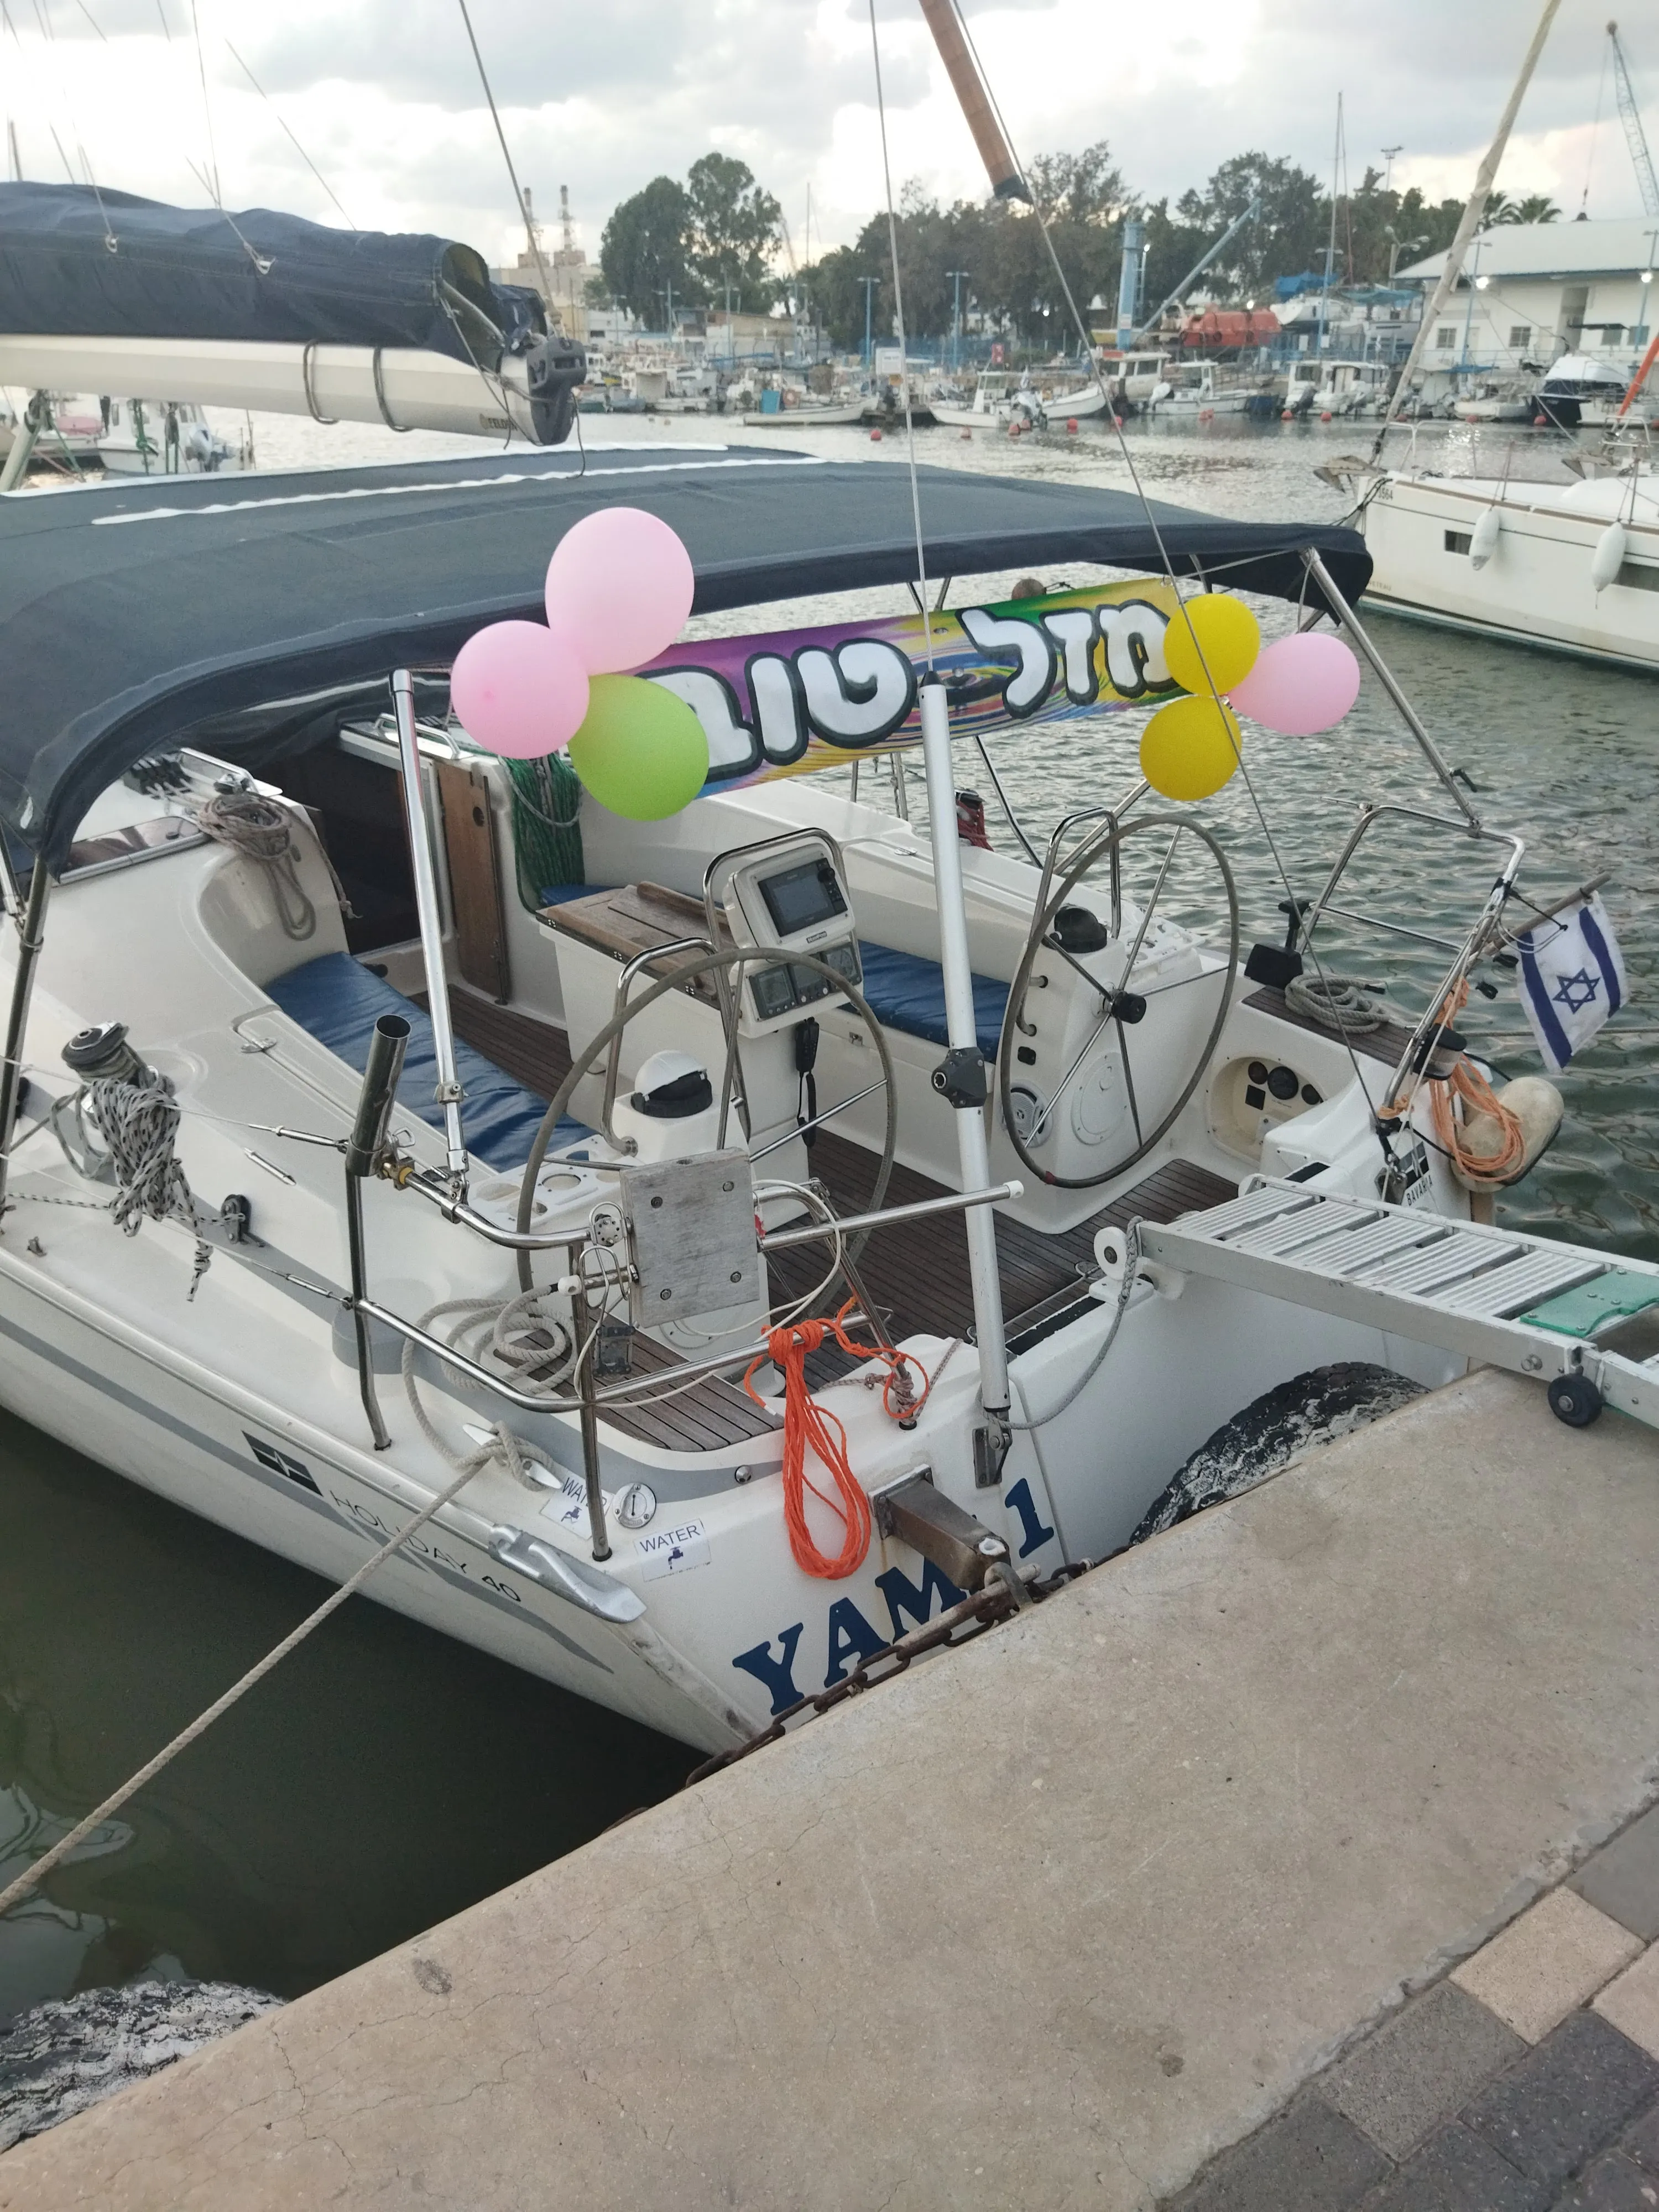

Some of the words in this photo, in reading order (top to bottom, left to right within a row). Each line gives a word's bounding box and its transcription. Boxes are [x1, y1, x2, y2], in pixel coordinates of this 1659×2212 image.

[954, 599, 1181, 719] מזל
[330, 1490, 467, 1574] HOLDAY
[481, 1575, 521, 1602] 40
[639, 1525, 701, 1553] WATER
[1004, 1477, 1055, 1559] 1
